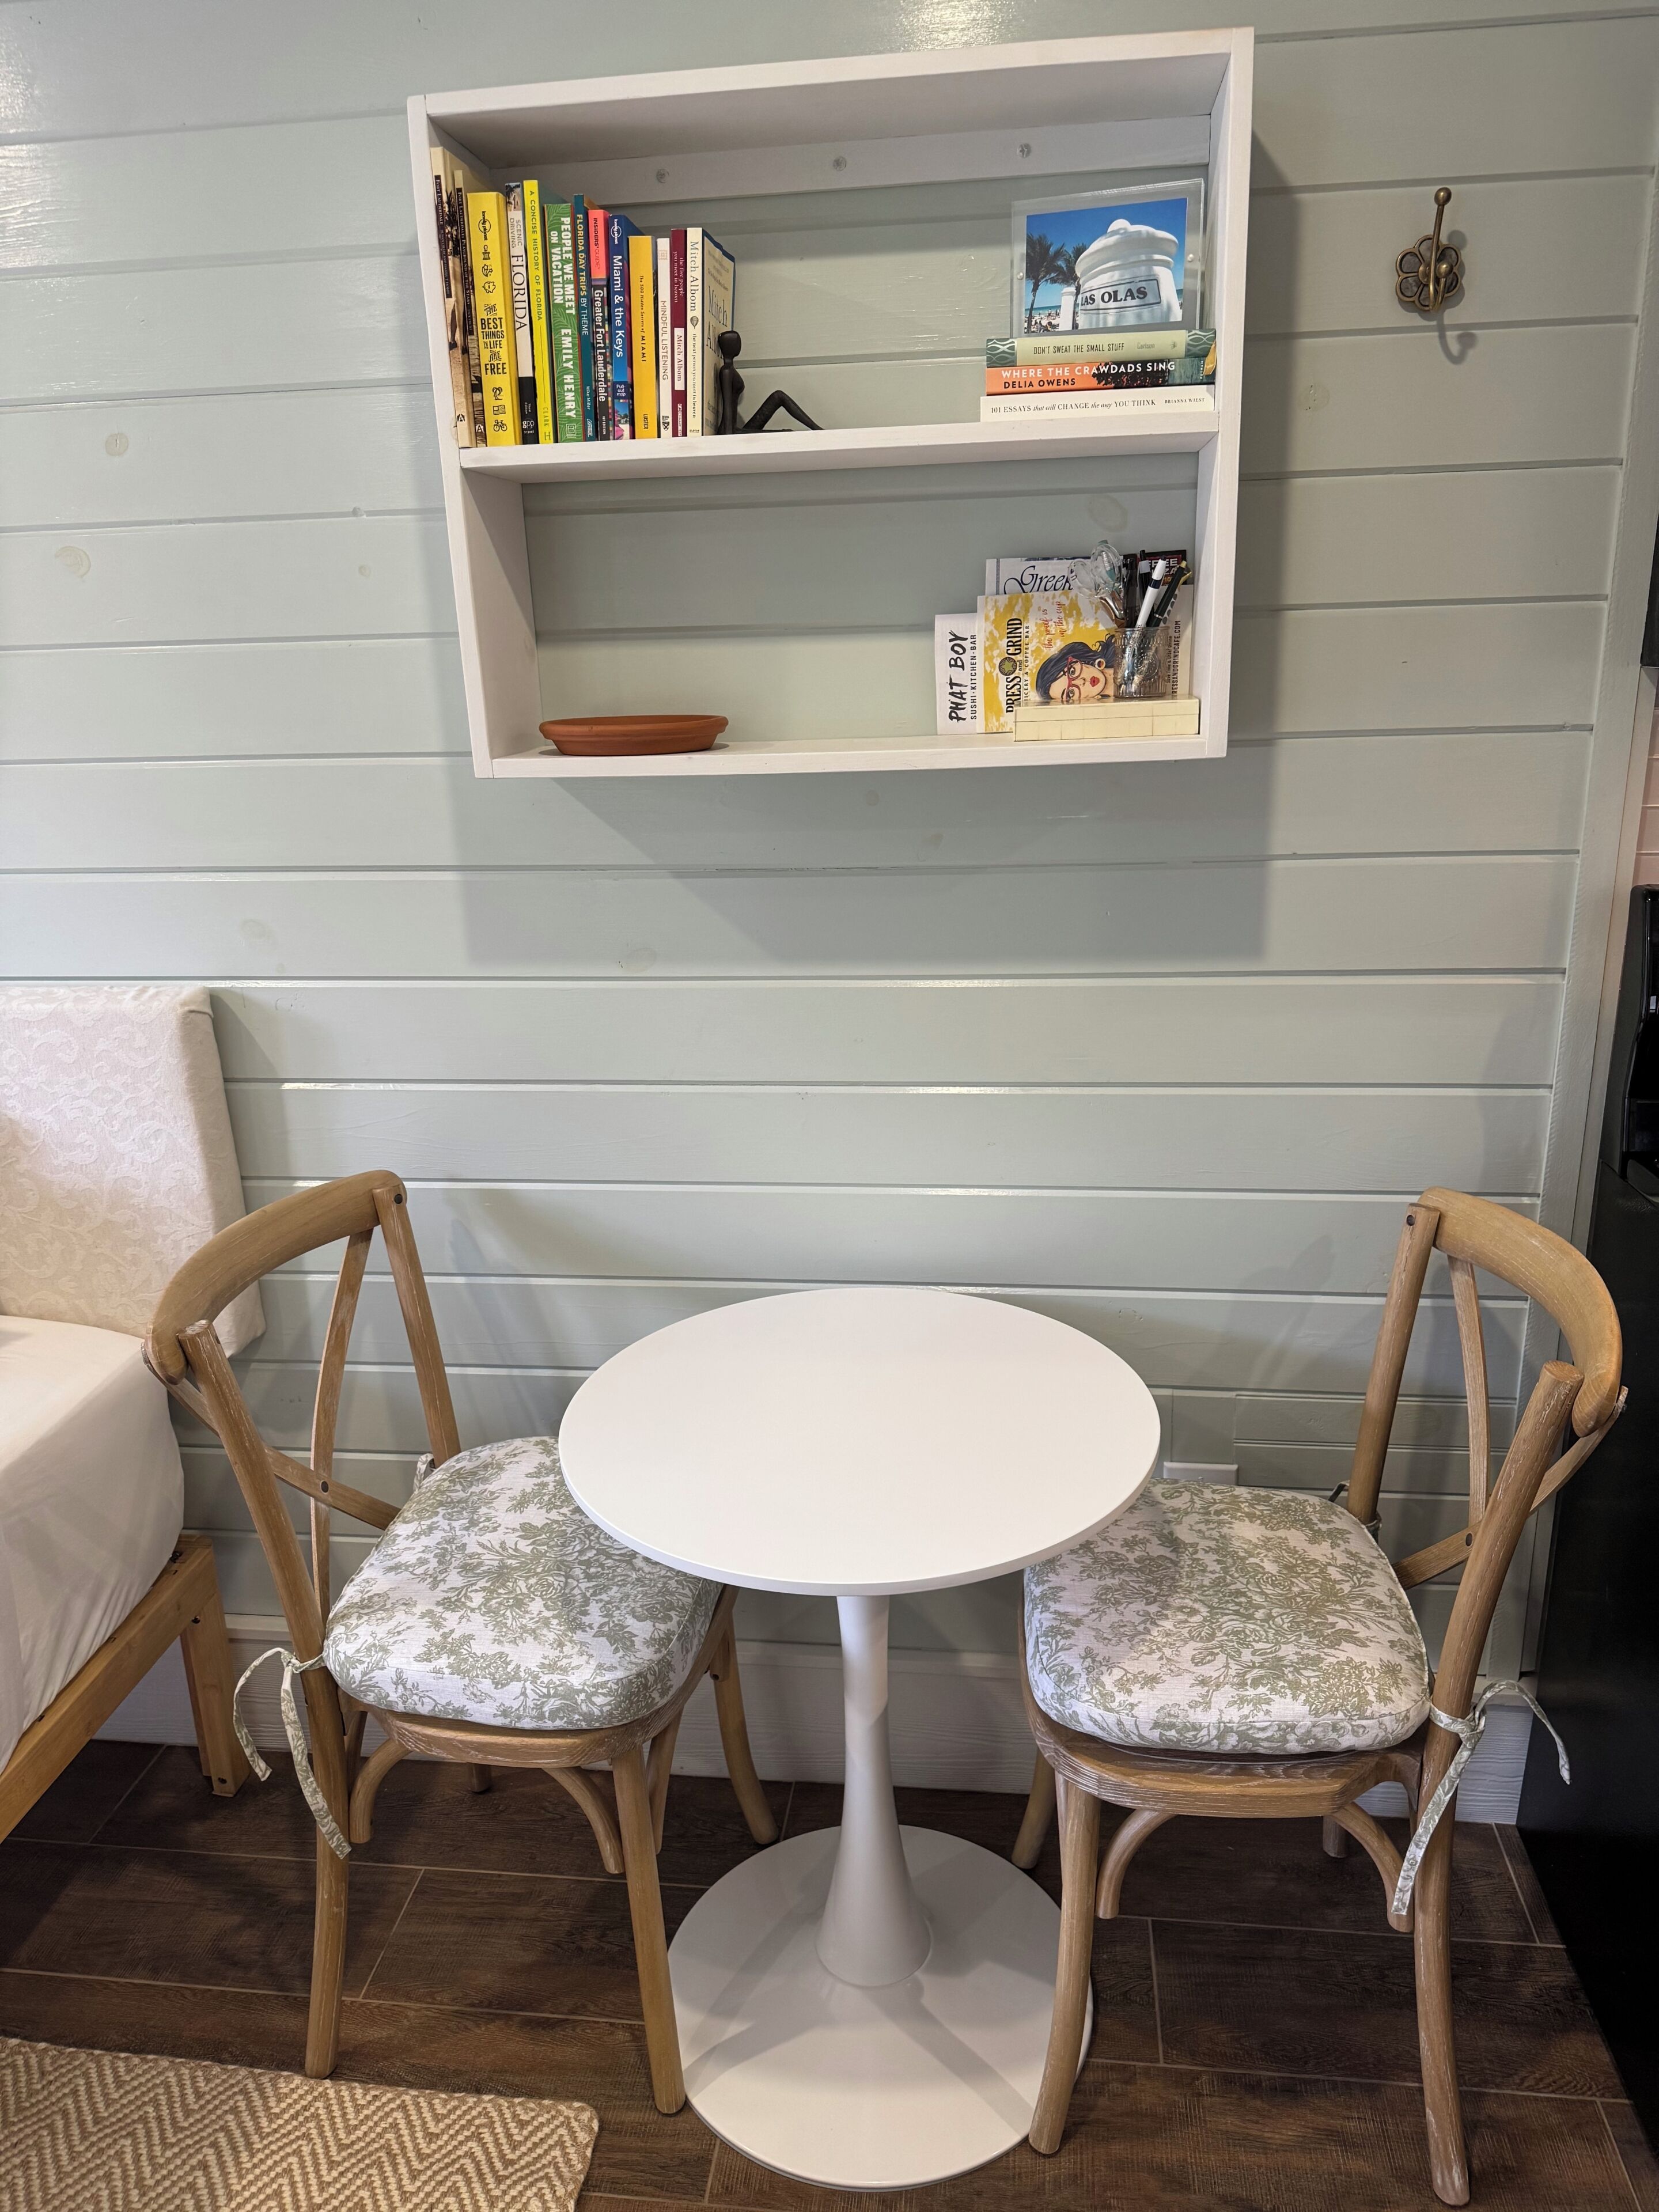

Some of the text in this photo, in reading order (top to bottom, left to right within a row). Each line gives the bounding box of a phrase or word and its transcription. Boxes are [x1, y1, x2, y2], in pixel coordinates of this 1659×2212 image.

[550, 231, 564, 304] ON VACATION
[561, 217, 575, 315] PEOPLE WE MEET
[535, 275, 540, 285] OF
[690, 241, 699, 312] Mitch Albom
[512, 255, 527, 331] FLORIDA
[1081, 286, 1147, 306] LAS OLAS
[484, 304, 497, 316] THE
[581, 298, 588, 308] BY
[613, 256, 624, 358] Miami & the Keys
[708, 285, 728, 327] Mitch
[480, 317, 503, 330] BEST
[481, 330, 505, 339] THINGS
[490, 340, 503, 349] LIFE
[561, 329, 573, 369] EMILY
[594, 290, 607, 402] Greater Fort Lauderdale
[1033, 343, 1124, 355] DON'T SWEAT THE SMALL STUFF
[1137, 342, 1156, 350] Carlson
[488, 350, 501, 362] ARE
[484, 362, 507, 376] FREE
[1002, 362, 1175, 378] WHERE THE CRAWDADS SING
[1003, 378, 1075, 389] DELIA OWENS
[563, 375, 576, 418] HENRY
[1039, 617, 1055, 635] proof
[1054, 601, 1067, 637] in the cup
[1006, 618, 1022, 656] GRIND
[1042, 638, 1054, 648] the
[1172, 620, 1181, 695] RESSANDGRINDCAFE.COM
[946, 630, 968, 723] PHAT BOY
